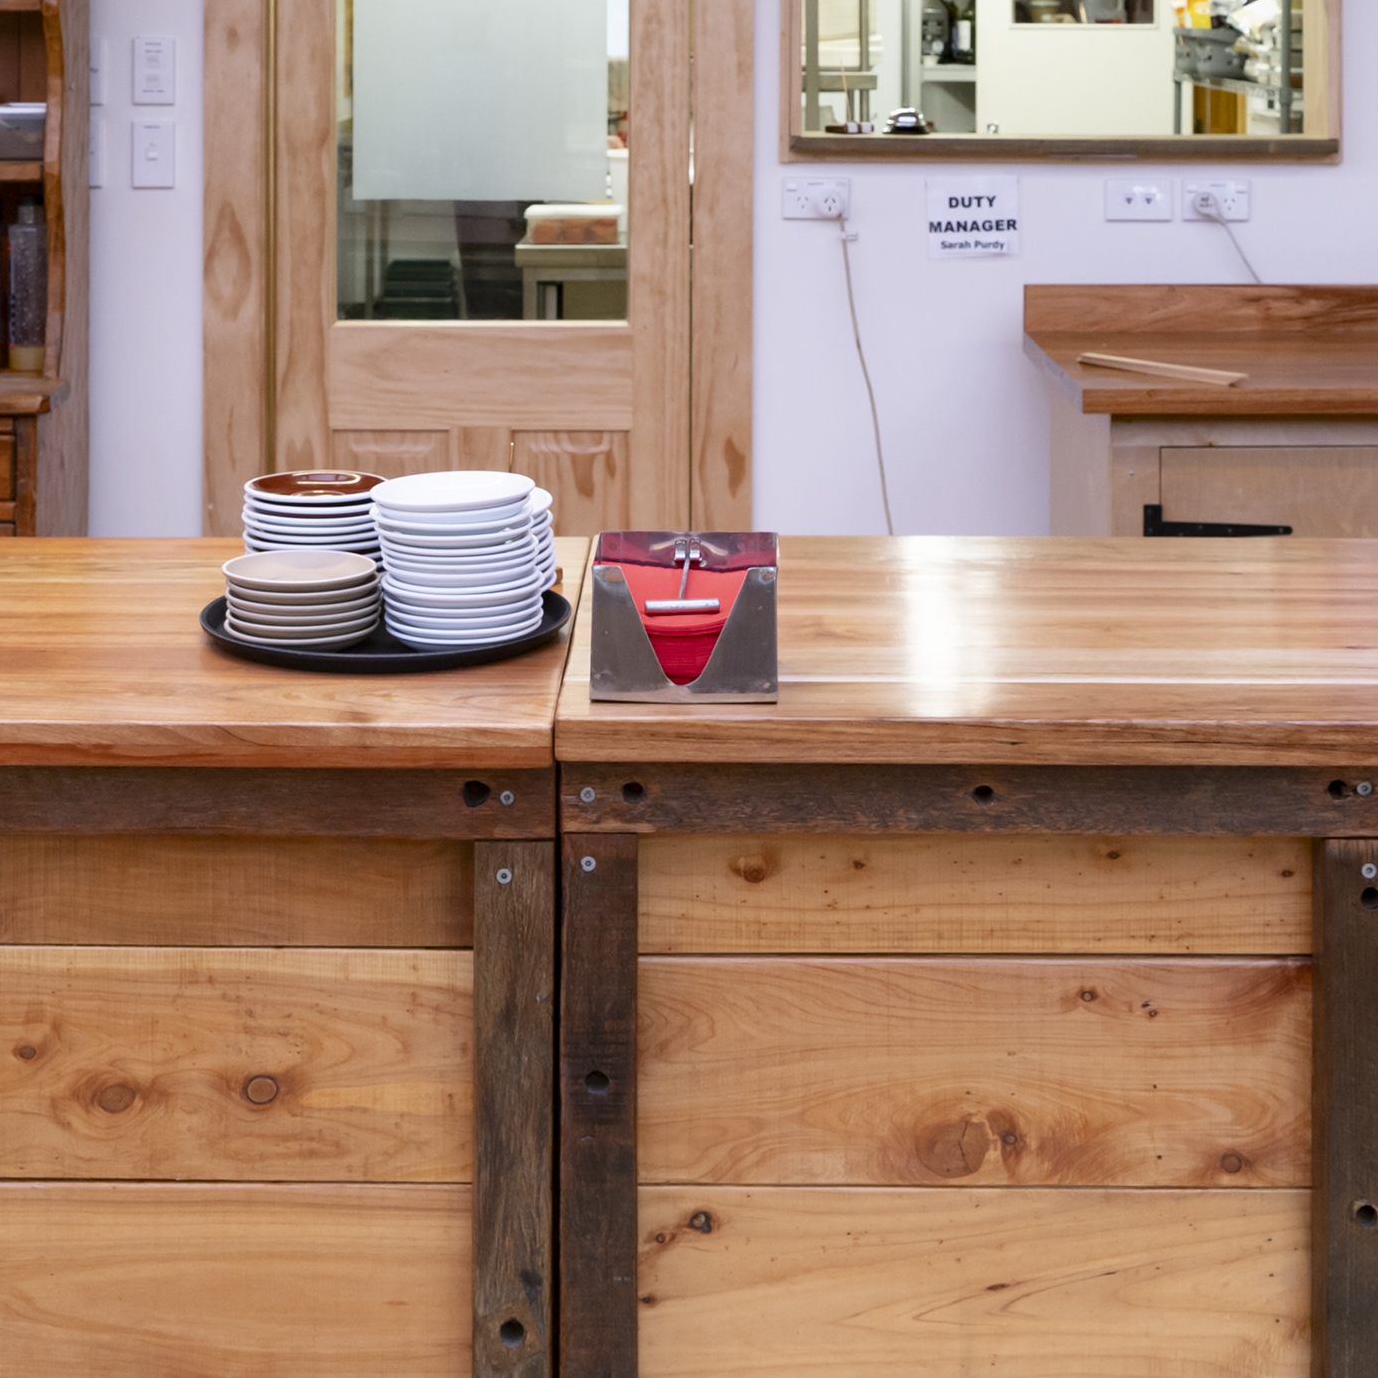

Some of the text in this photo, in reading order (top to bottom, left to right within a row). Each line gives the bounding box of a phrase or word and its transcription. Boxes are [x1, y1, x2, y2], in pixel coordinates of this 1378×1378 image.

[949, 195, 996, 208] DUTY
[929, 219, 1017, 233] MANAGER
[941, 240, 1005, 250] Sarah Purdy
